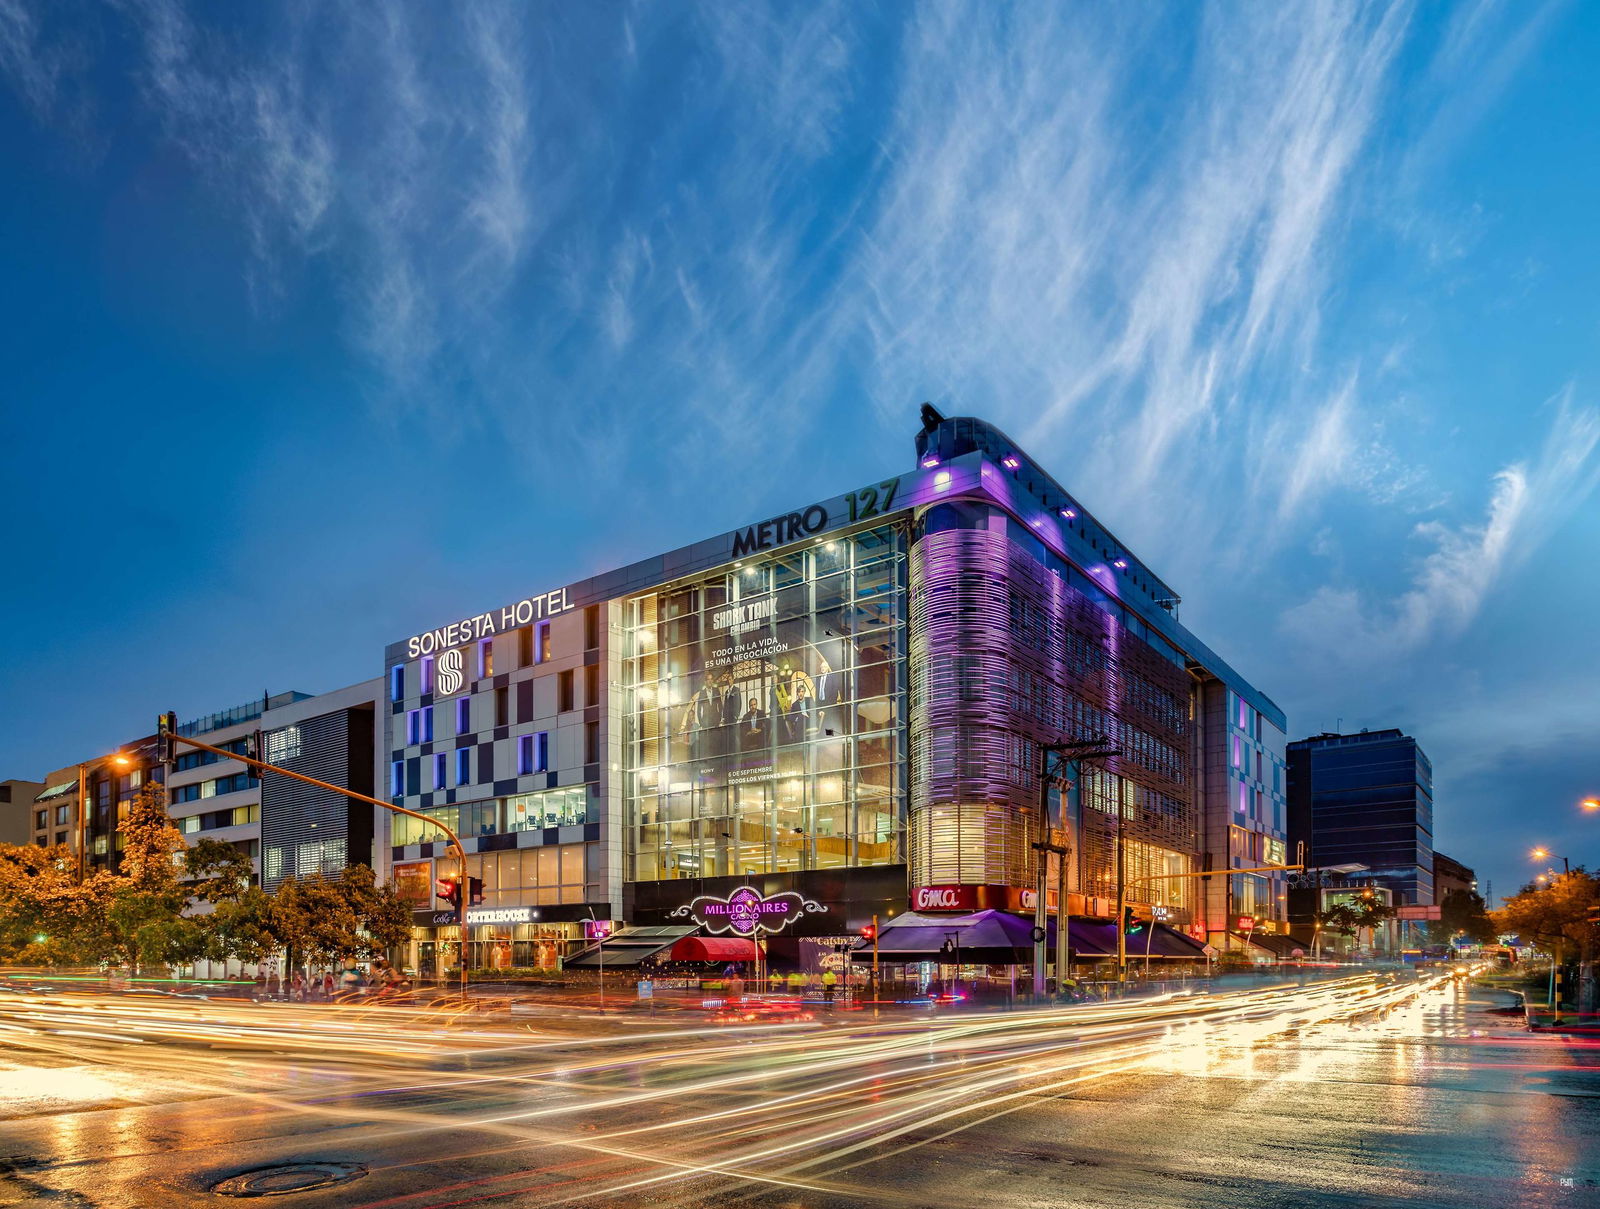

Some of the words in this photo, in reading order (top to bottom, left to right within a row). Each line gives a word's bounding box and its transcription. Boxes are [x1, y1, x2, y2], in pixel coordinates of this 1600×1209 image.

[732, 504, 828, 559] METRO
[845, 478, 900, 522] 127
[408, 612, 496, 658] SONESTA
[501, 587, 575, 630] HOTEL
[713, 605, 746, 630] SHARK
[747, 596, 778, 622] TANK
[705, 659, 714, 669] ES
[715, 656, 732, 666] UNA
[733, 643, 788, 662] NEGOCIACIÓN
[712, 647, 733, 658] TODO
[735, 644, 745, 653] EN
[747, 641, 757, 650] LA
[759, 636, 778, 647] VIDA
[728, 777, 746, 785] TODOS
[740, 766, 772, 776] SEPTIEMBRE
[466, 909, 530, 923] ORTERHOUSE
[705, 902, 788, 915] MILLIONAIRES
